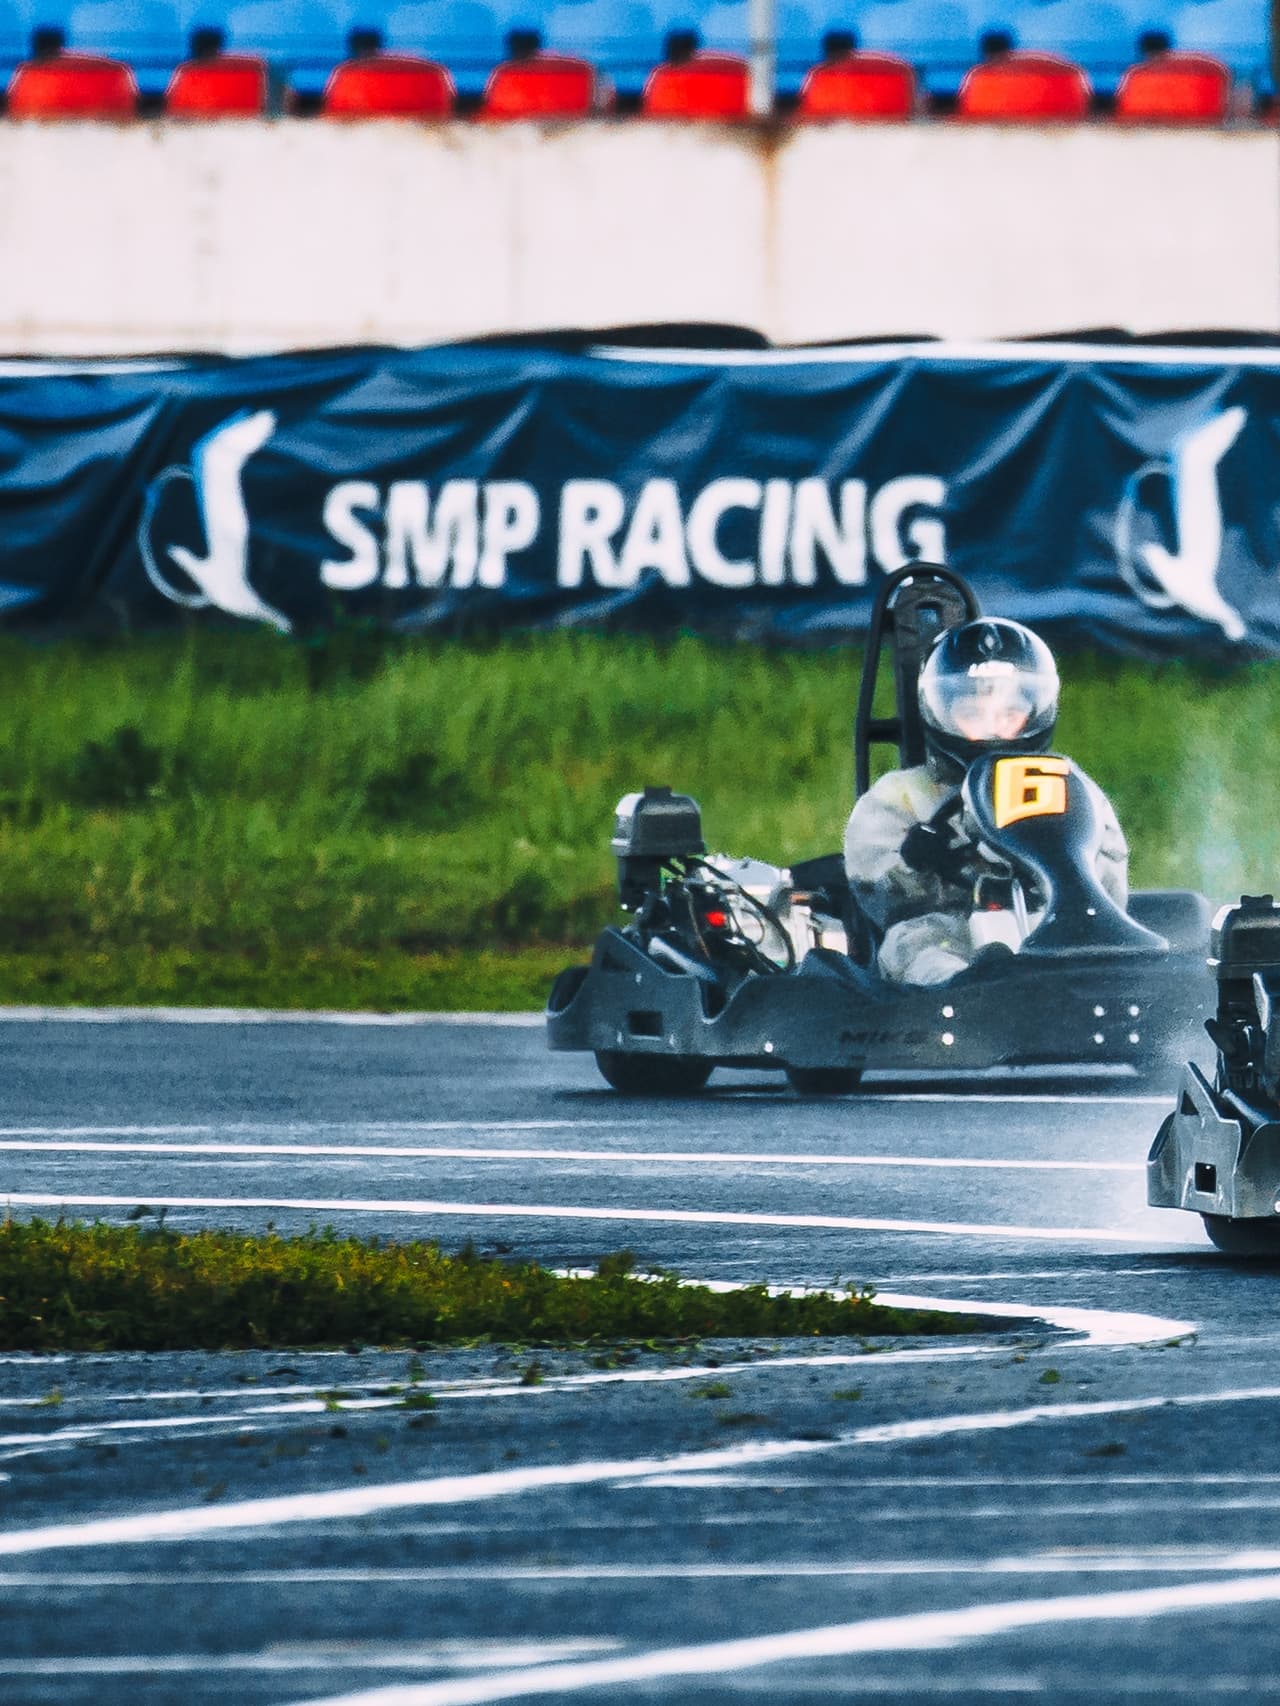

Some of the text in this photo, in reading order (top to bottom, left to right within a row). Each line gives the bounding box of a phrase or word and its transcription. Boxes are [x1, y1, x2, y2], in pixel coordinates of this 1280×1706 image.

[319, 474, 946, 590] SMP RACING
[994, 756, 1071, 829] 6
